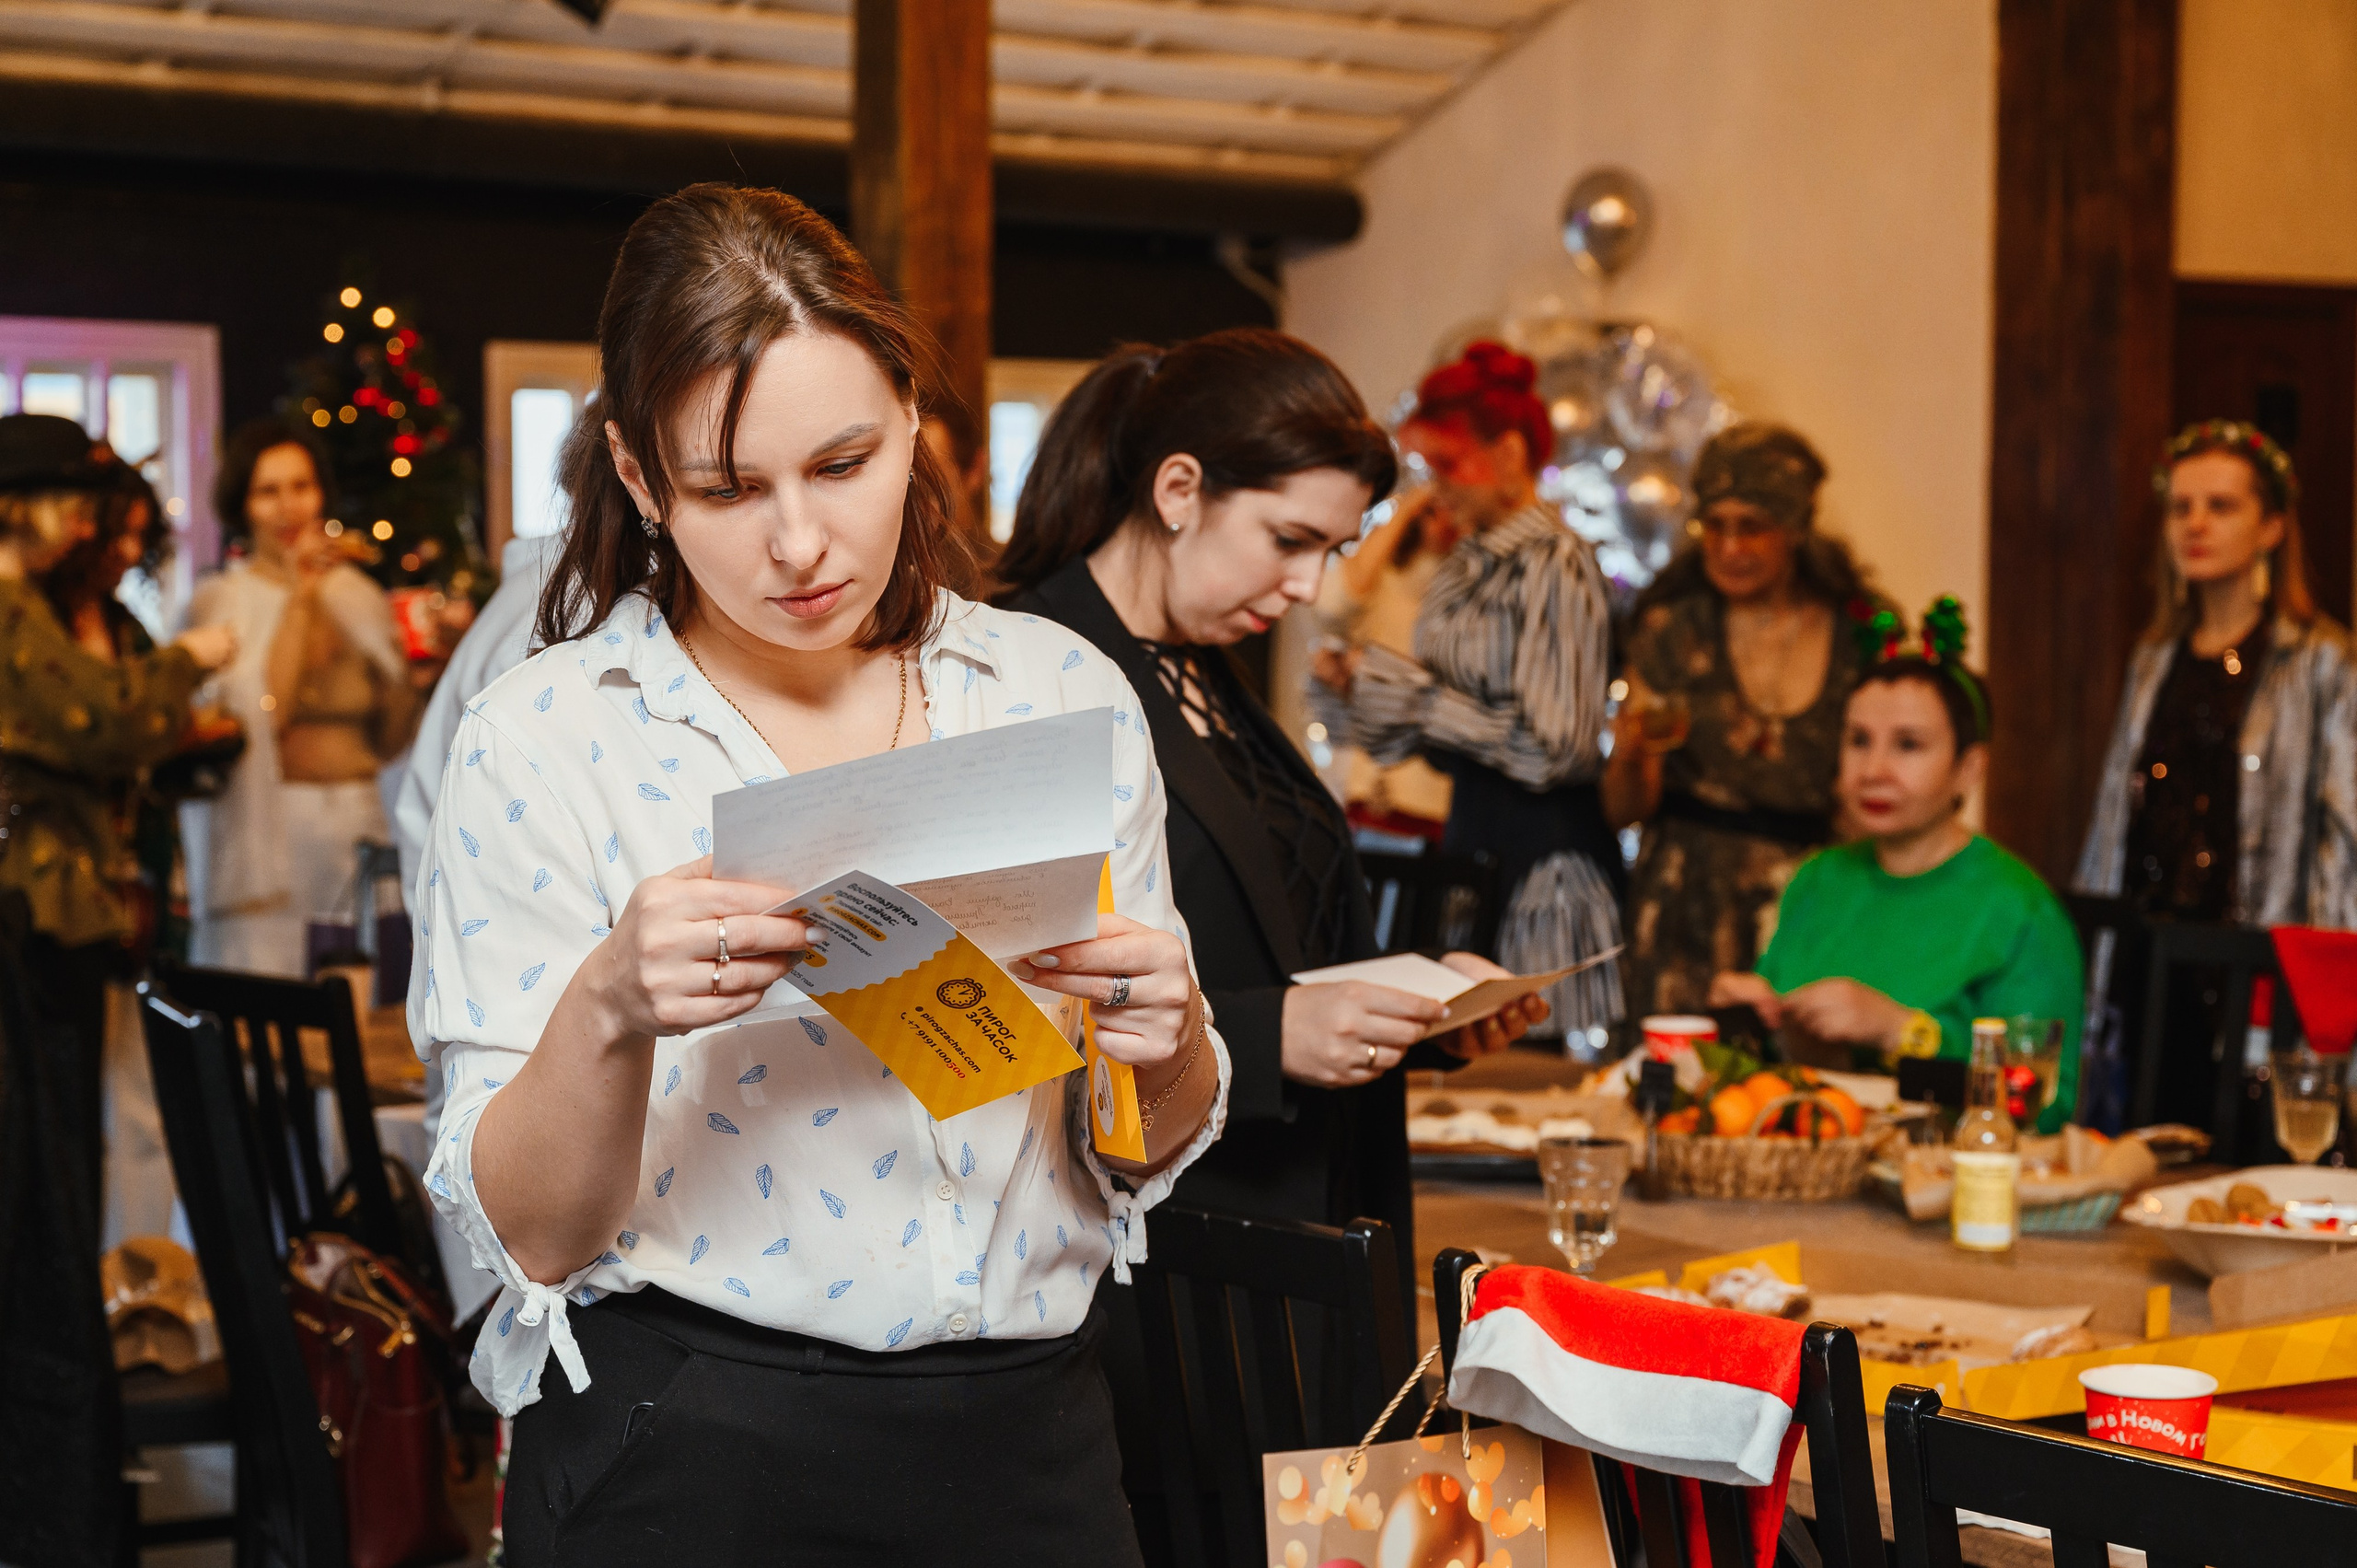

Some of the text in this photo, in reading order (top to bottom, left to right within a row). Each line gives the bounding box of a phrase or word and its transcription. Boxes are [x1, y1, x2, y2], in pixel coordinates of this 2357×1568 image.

[828, 906, 882, 938] PIROGZACHAS.COM
[834, 889, 900, 926] прямо сейчас:
[847, 883, 919, 926] Воспользуйтесь
[870, 917, 883, 927] сайт
[850, 941, 872, 957] аккаунт
[790, 970, 815, 988] 025 года
[965, 1011, 1018, 1063] ЗА ЧАСОК
[978, 1005, 1016, 1040] ПИРОГ
[908, 1019, 966, 1079] +7 9191 100500
[920, 1013, 981, 1074] pirogzachas.com
